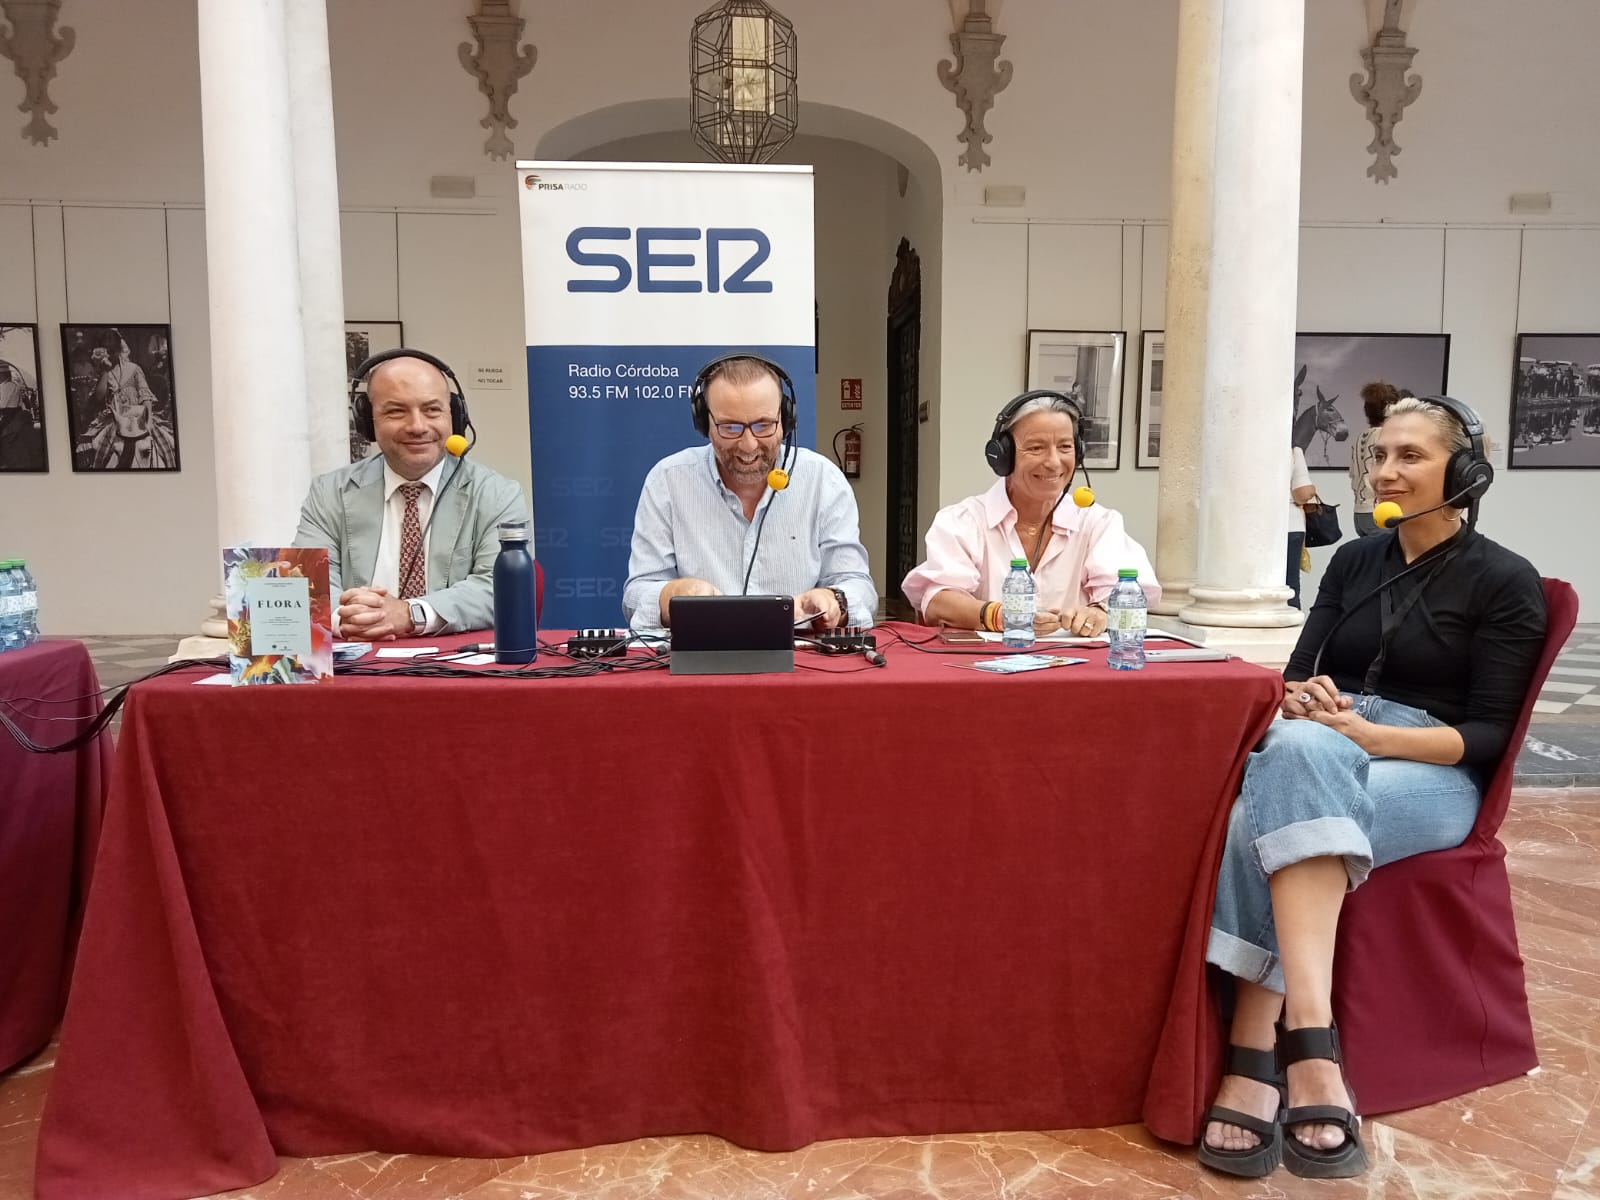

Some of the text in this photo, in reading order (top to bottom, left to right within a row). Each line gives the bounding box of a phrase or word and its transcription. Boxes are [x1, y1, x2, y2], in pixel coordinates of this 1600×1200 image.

[538, 183, 564, 191] PRISA
[565, 226, 773, 294] SER
[568, 364, 679, 378] Radio Córdoba
[568, 385, 601, 399] 93.5
[605, 385, 629, 399] FM
[633, 385, 674, 399] 102.0
[551, 477, 615, 497] SER
[535, 528, 569, 547] ER
[600, 527, 634, 547] SE
[554, 578, 618, 598] SER
[257, 600, 302, 608] FLORA
